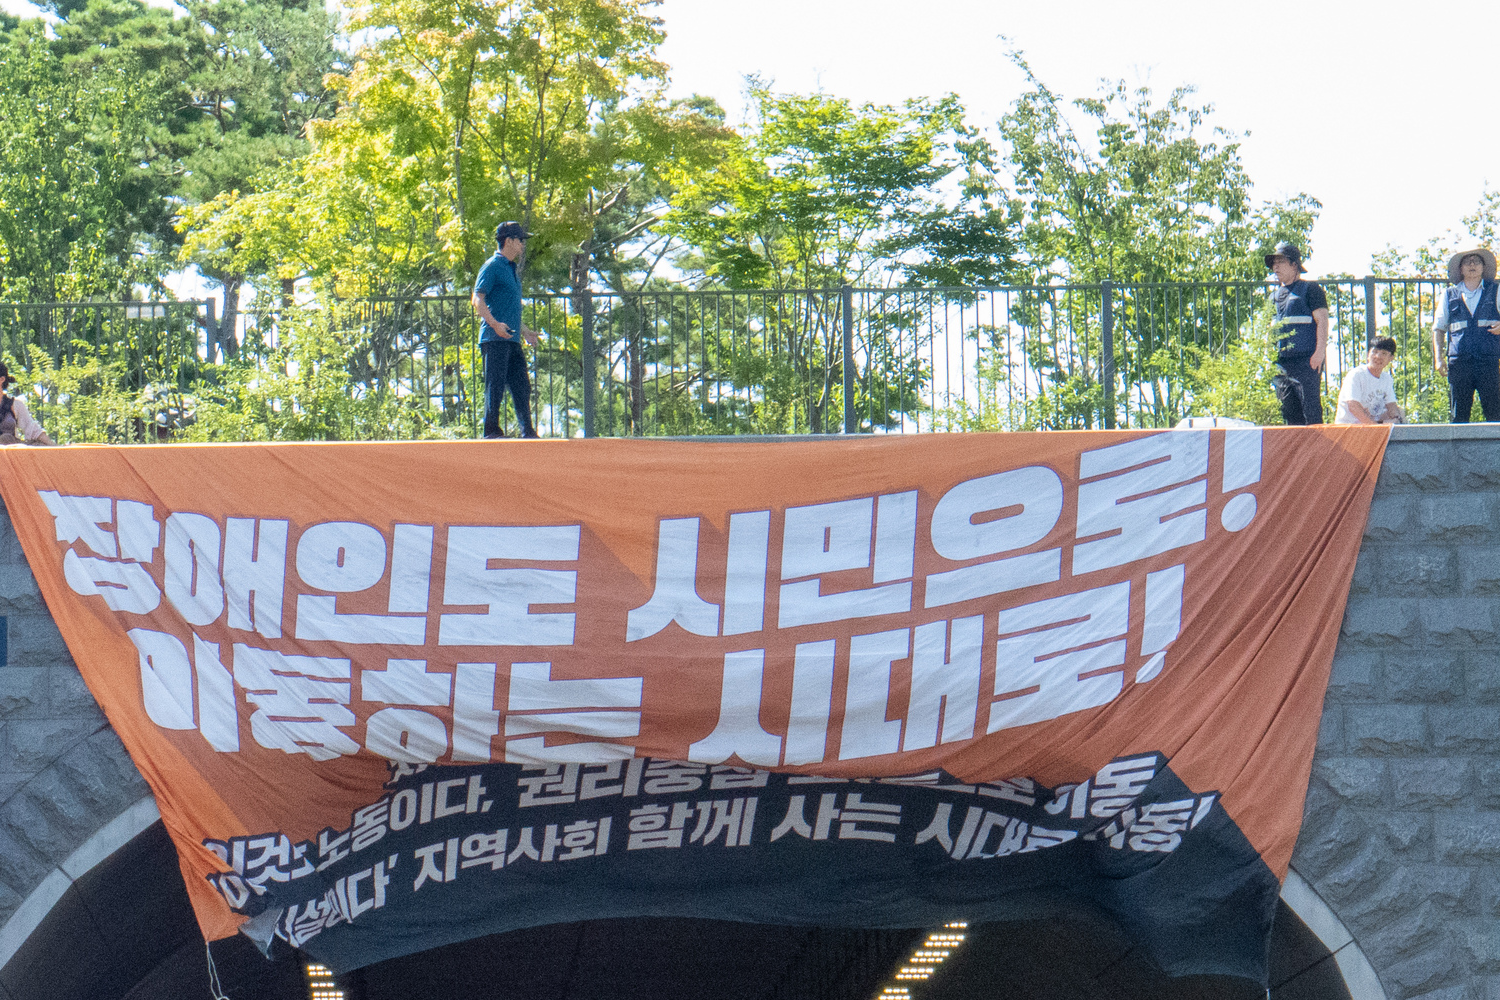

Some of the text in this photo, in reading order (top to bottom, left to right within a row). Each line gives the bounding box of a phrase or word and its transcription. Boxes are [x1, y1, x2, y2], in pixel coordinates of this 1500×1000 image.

[37, 428, 1263, 646] 장애인도 시민으로!
[127, 564, 1186, 768] 이동하는 시대로!
[414, 815, 613, 892] 지역사회
[626, 797, 759, 851] 함께
[770, 793, 902, 843] 사는
